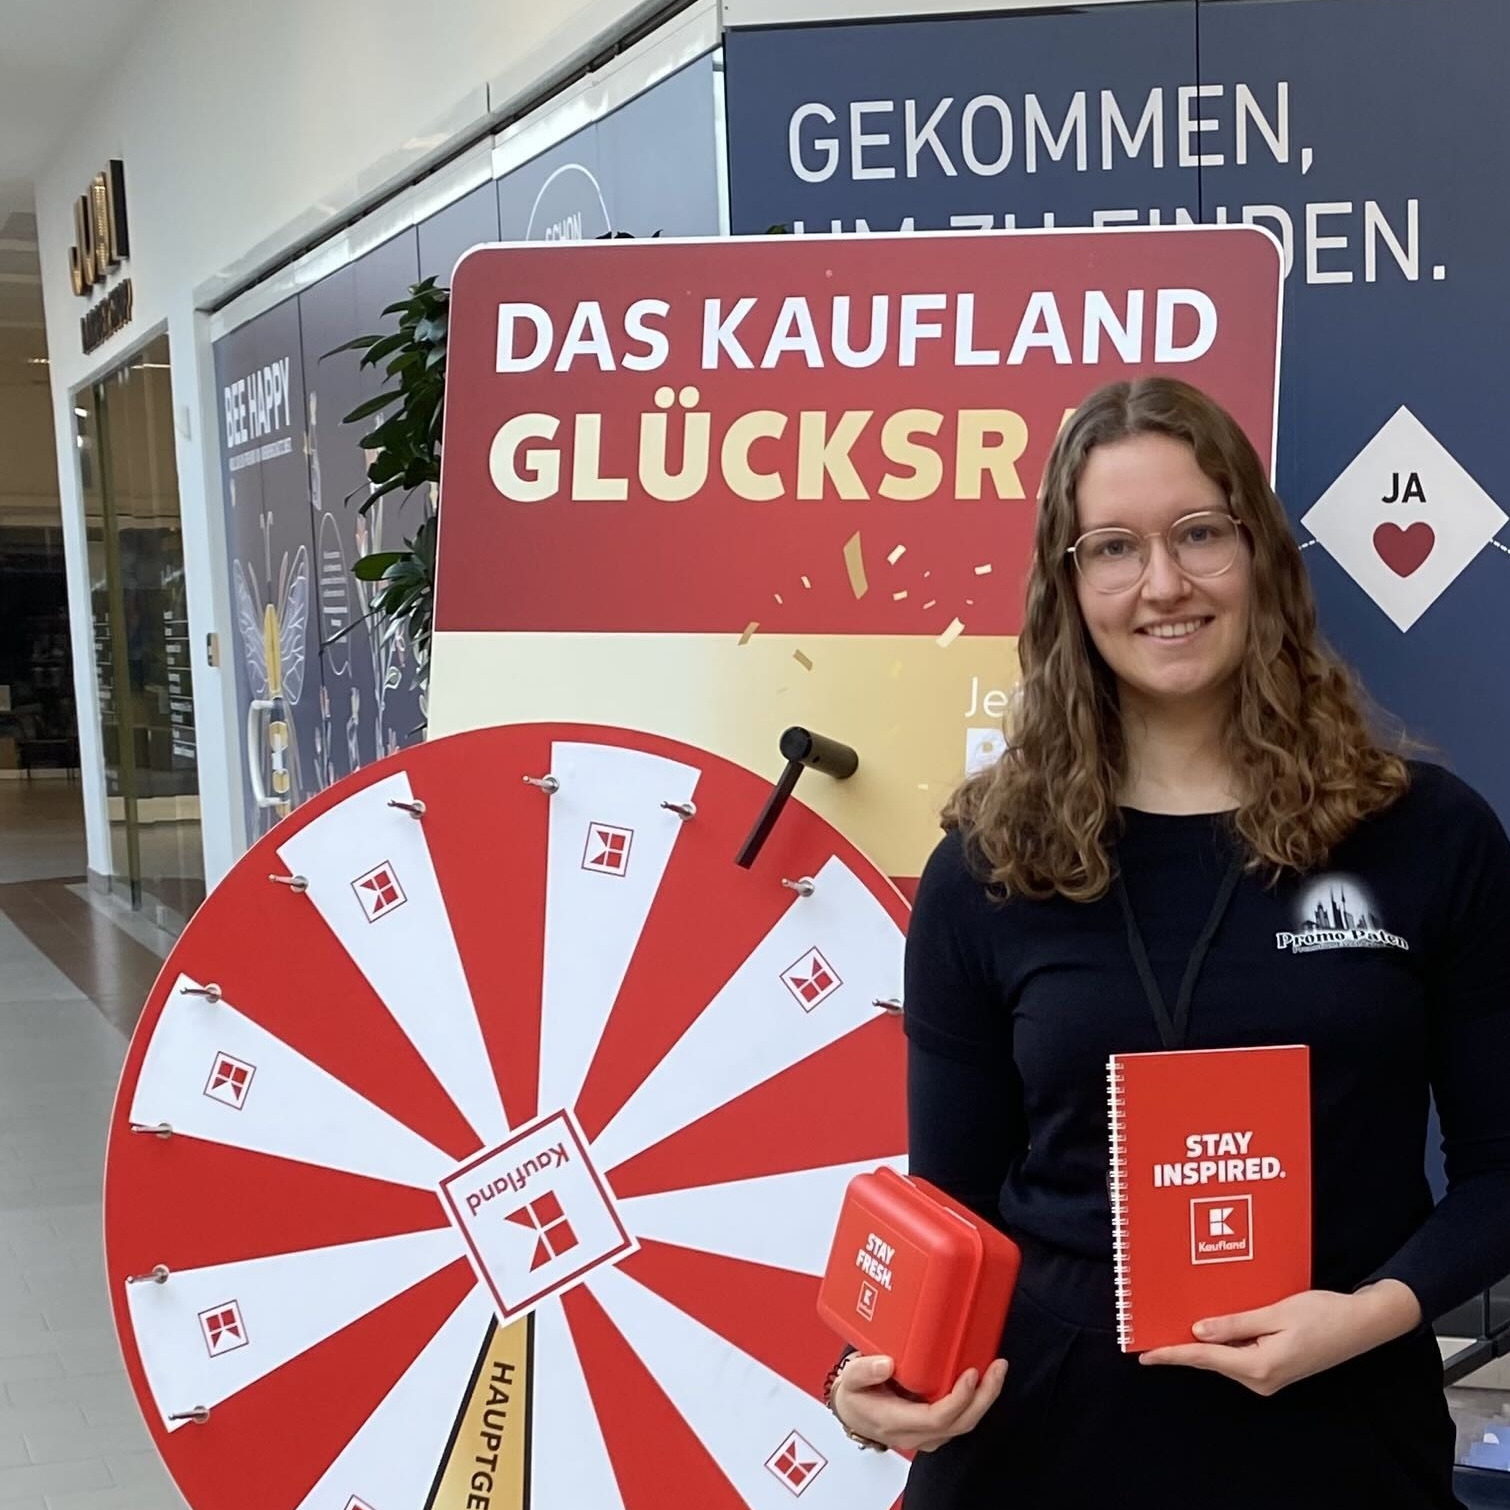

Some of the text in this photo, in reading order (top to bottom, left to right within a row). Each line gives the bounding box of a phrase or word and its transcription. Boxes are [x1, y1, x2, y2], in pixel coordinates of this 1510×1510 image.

[788, 81, 1314, 183] GEKOMMEN,
[495, 287, 1219, 374] DAS KAUFLAND
[224, 357, 290, 448] BEE HAPPY
[488, 386, 1075, 503] GLÜCKSR
[1381, 473, 1427, 504] JA
[1276, 931, 1346, 949] Promo
[1185, 1131, 1253, 1159] STAY
[466, 1142, 570, 1216] Kaufland
[1154, 1156, 1287, 1188] INSPIRED.
[866, 1233, 896, 1266] STAY
[1198, 1238, 1247, 1253] Kaufland
[856, 1248, 892, 1291] FRESH.
